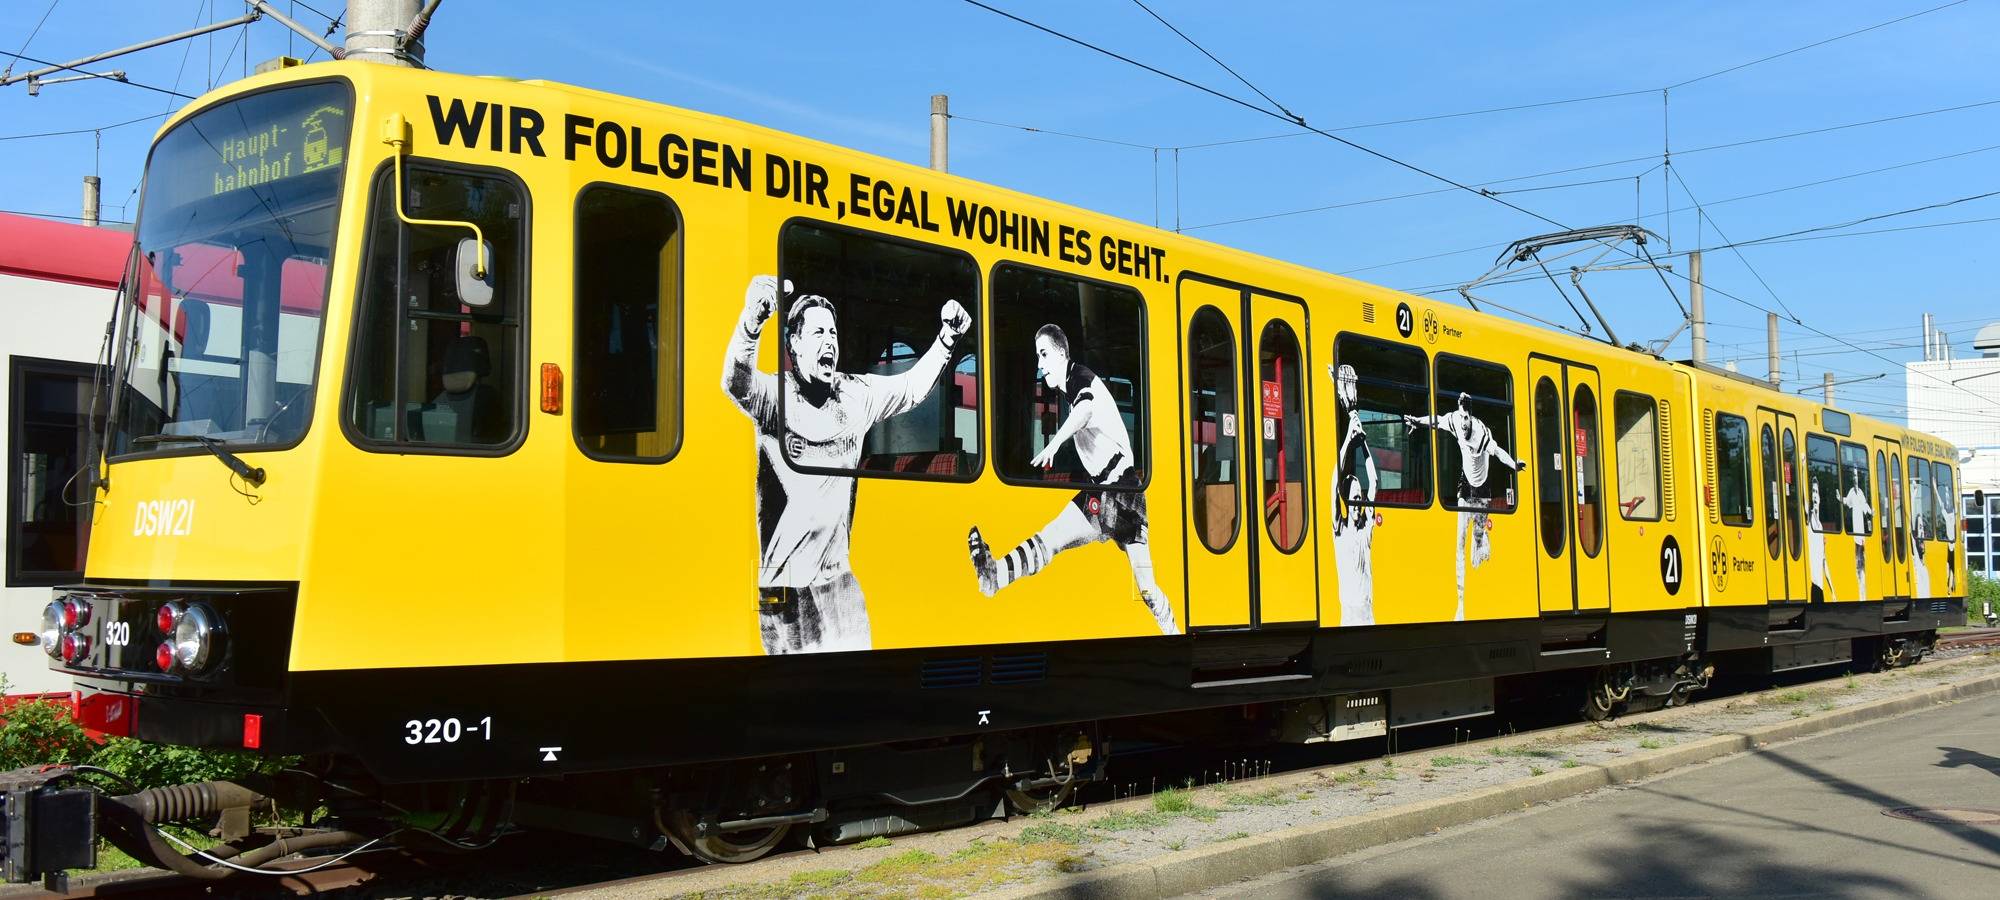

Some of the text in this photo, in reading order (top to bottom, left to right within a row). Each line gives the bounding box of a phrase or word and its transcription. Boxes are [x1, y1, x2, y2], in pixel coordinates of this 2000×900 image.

[223, 124, 287, 163] Haupt-
[214, 152, 291, 194] bahnhof
[426, 94, 547, 158] WIR
[564, 113, 752, 192] FOLGEN
[765, 153, 830, 209] DIR
[946, 196, 1050, 257] WOHIN
[1059, 224, 1092, 266] ES
[1099, 235, 1170, 284] GEHT.
[1399, 308, 1410, 331] 21
[1443, 325, 1462, 338] Partner
[133, 499, 195, 536] DSW21
[1664, 547, 1679, 583] 21
[1732, 556, 1754, 572] Partner
[105, 621, 130, 647] 320
